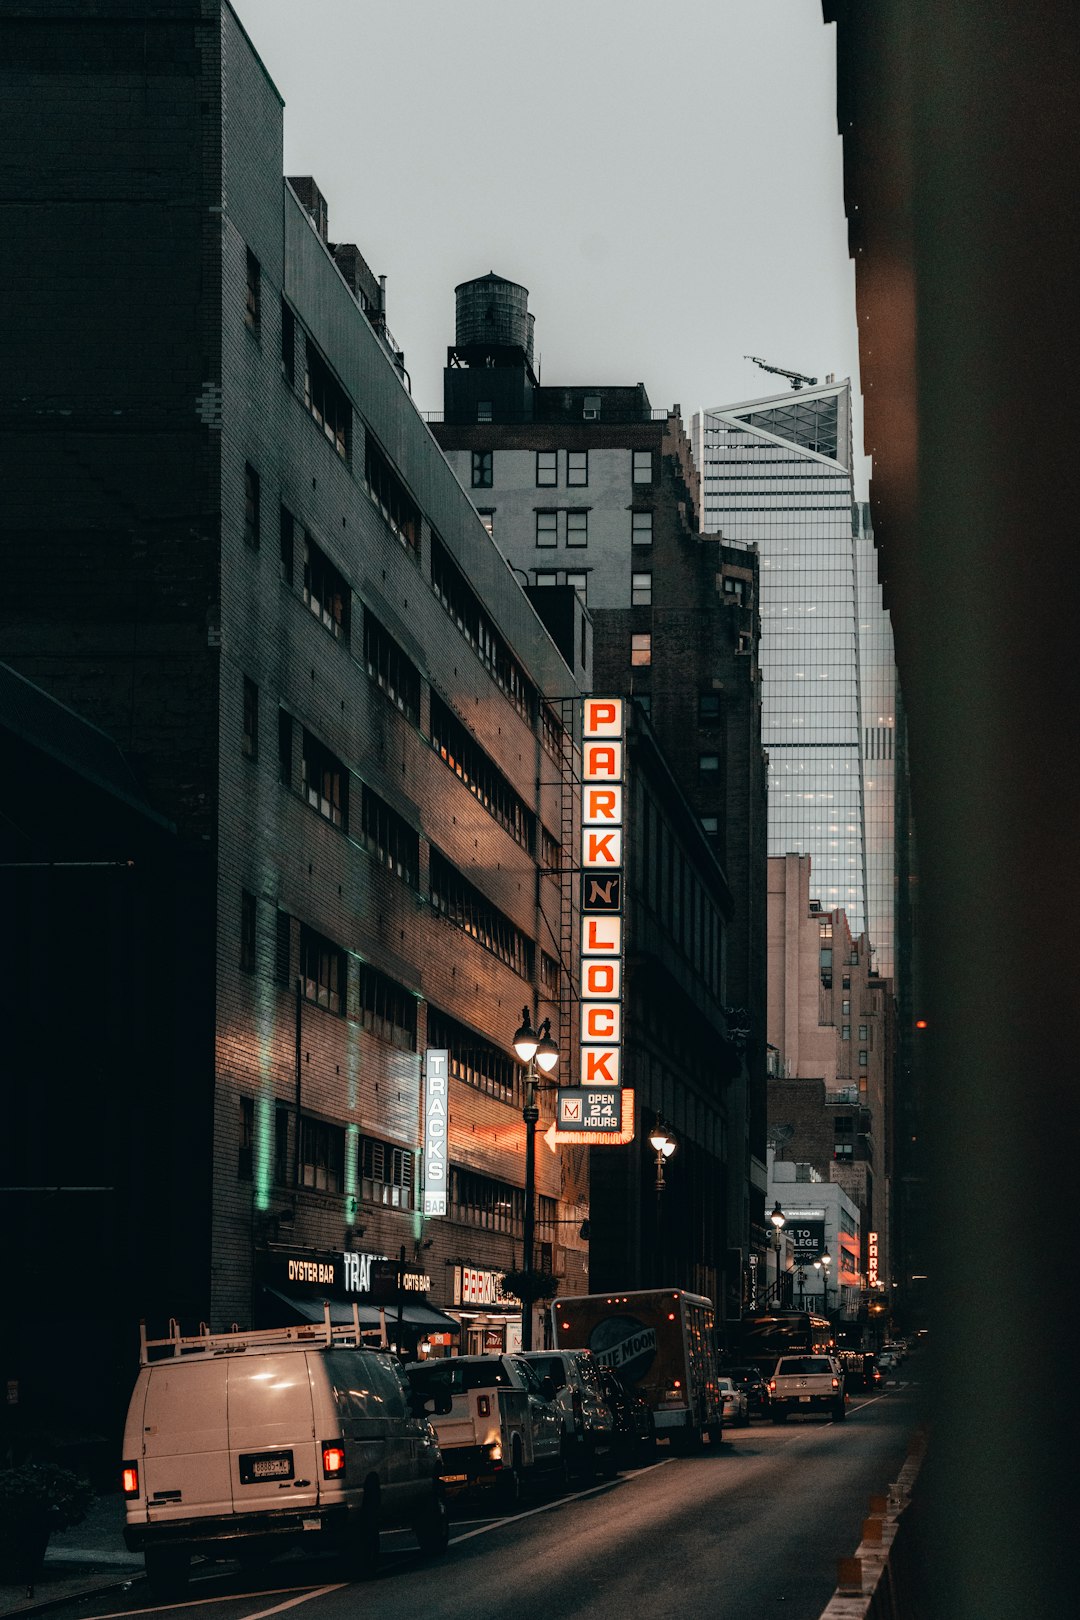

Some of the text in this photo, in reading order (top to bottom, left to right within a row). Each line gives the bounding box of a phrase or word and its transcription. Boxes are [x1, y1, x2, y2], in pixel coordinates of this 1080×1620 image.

[589, 704, 616, 862] PARK
[587, 921, 614, 1080] LOCK
[587, 1093, 615, 1104] OPEN
[428, 1056, 445, 1180] TRACKS
[590, 1104, 613, 1116] 24
[583, 1116, 618, 1127] HOURS
[425, 1200, 445, 1213] BAR
[794, 1238, 818, 1246] LEGE
[796, 1230, 810, 1238] TO
[869, 1232, 878, 1282] PARK
[288, 1259, 335, 1284] OYSTER BAR
[418, 1273, 431, 1292] BAR
[622, 1331, 655, 1360] MOON
